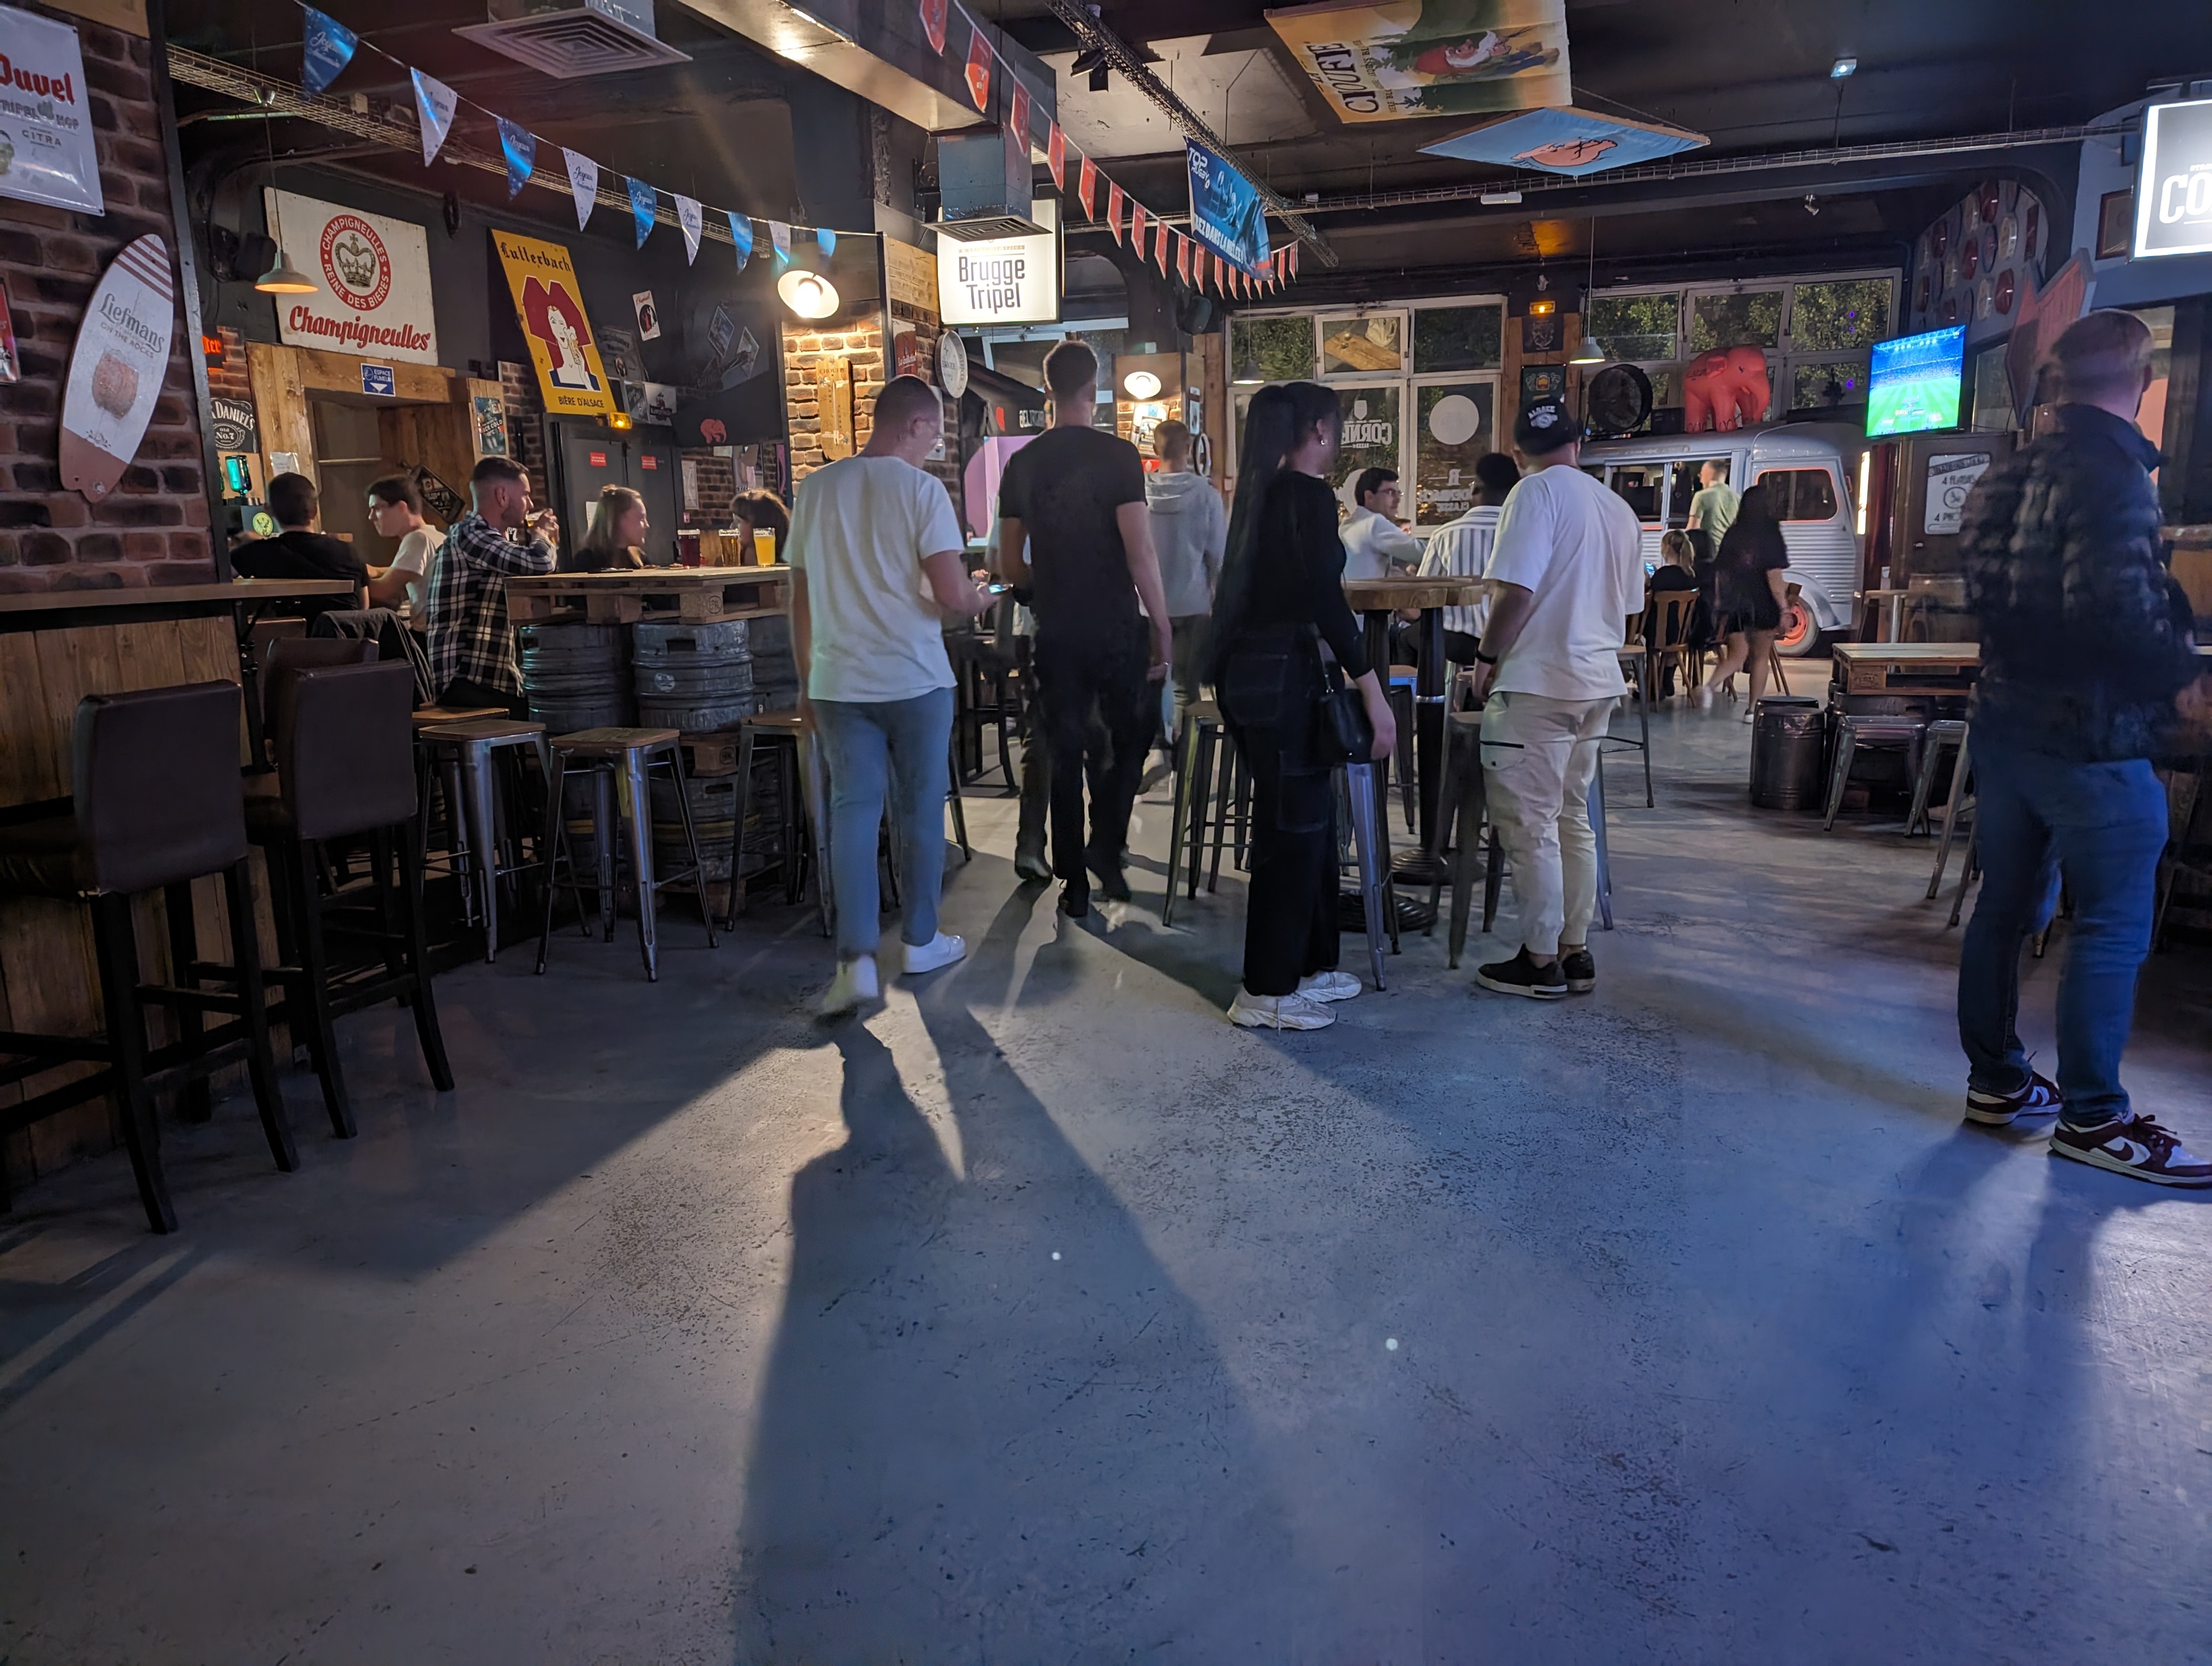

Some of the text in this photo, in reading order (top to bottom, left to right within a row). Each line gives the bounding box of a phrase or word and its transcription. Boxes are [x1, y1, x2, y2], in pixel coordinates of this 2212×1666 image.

[22, 130, 61, 146] CITRA
[510, 134, 530, 152] Joyeux
[1188, 146, 1208, 168] TOP
[573, 165, 593, 182] Joyeux
[1191, 164, 1210, 181] RUGBY
[2189, 163, 2212, 172] STRO
[2159, 172, 2212, 224] CO
[322, 217, 387, 263] CHAMPIGNEULLES
[958, 255, 1025, 286] Brugge
[324, 264, 389, 309] REINE DES BIERES
[966, 282, 1021, 314] Tripel
[98, 293, 165, 353] Liefmans
[290, 305, 431, 351] Champigneulles
[100, 322, 113, 333] ON
[114, 329, 128, 343] THE
[374, 369, 391, 377] ESPACE
[374, 375, 391, 383] FUMEUR
[558, 396, 605, 408] BIÈRE D'ALSACE
[215, 401, 255, 431] DANIEL'S
[490, 419, 503, 429] COLD
[216, 432, 235, 440] No.7
[1942, 476, 1947, 485] 4
[1934, 513, 1940, 522] 4
